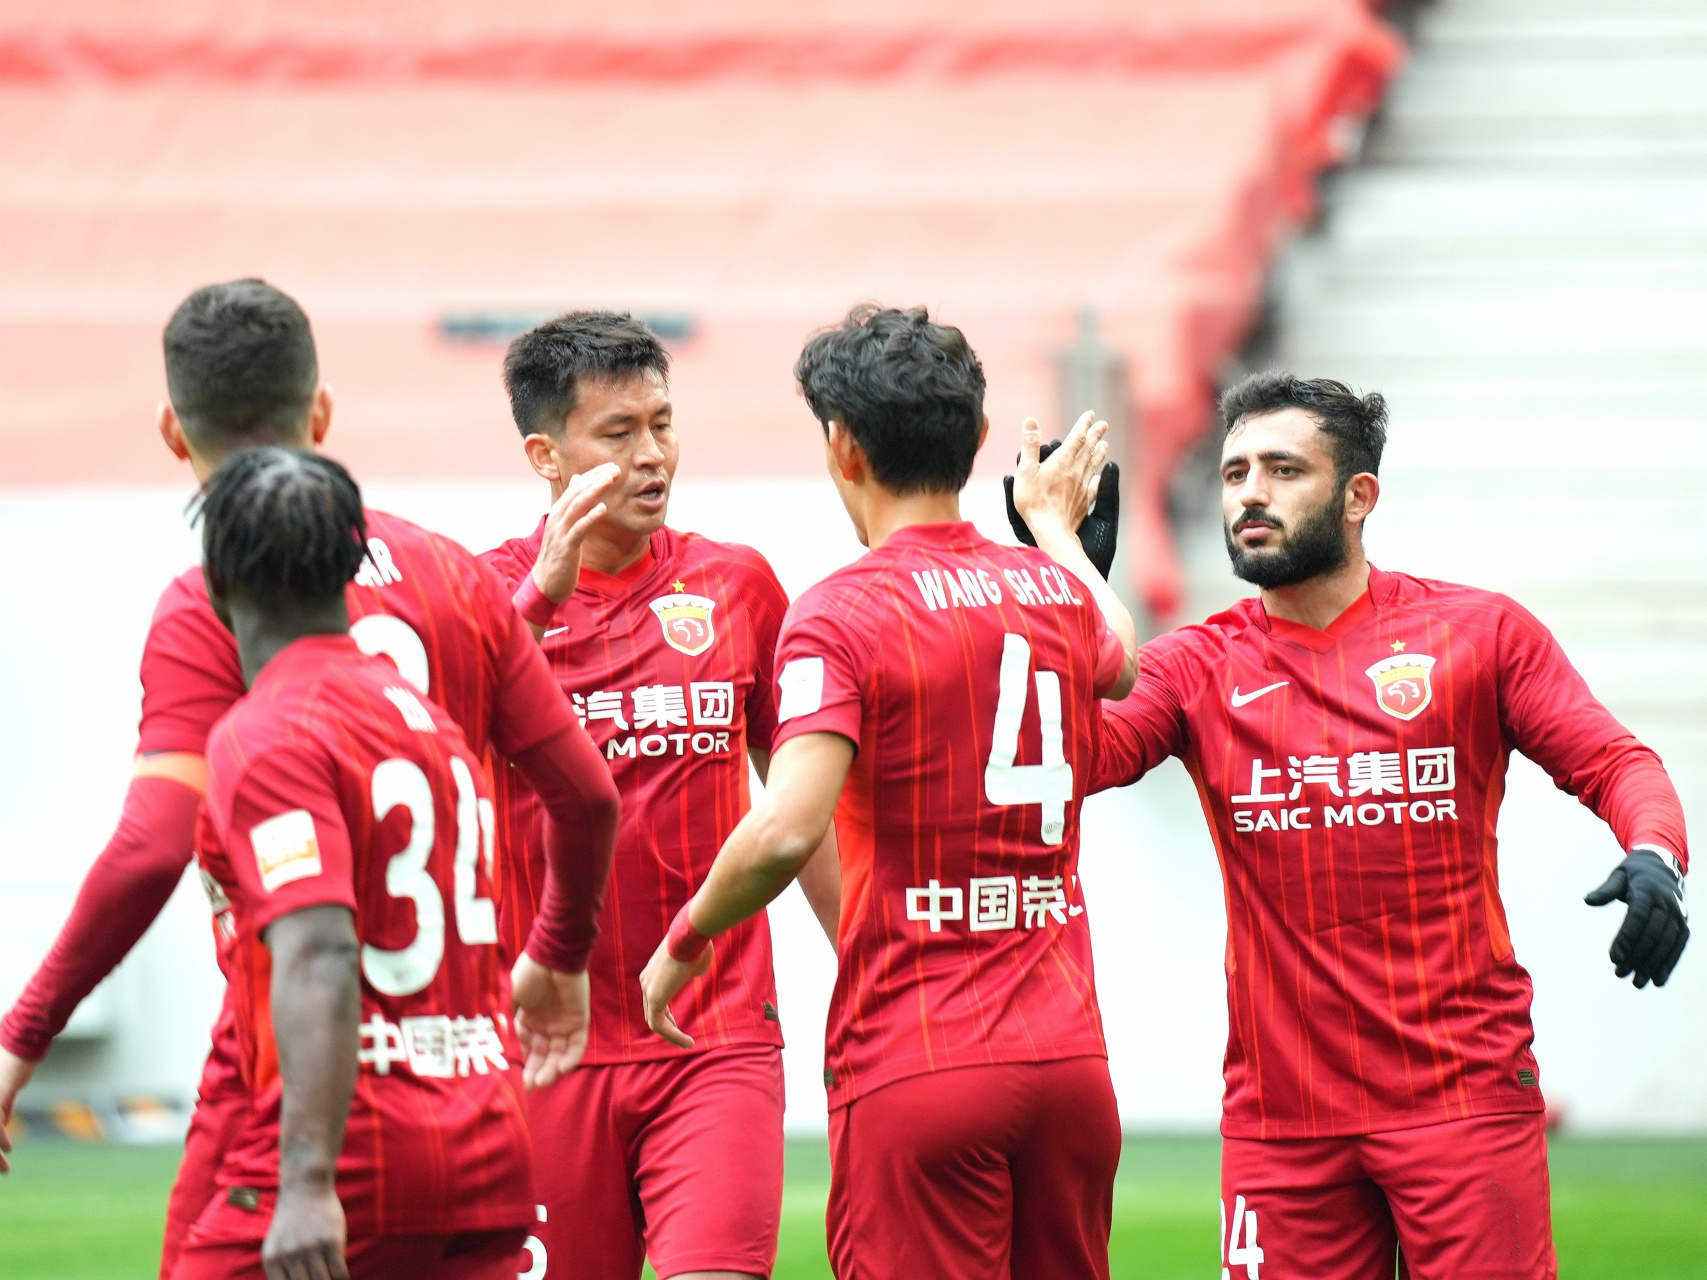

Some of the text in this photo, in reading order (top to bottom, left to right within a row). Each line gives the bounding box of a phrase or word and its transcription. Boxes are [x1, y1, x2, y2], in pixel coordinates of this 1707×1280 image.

[354, 537, 403, 588] AR
[911, 568, 1003, 611] WANG
[607, 731, 730, 760] MOTOR
[984, 632, 1074, 845] 4
[1231, 746, 1456, 804] 上汽集团
[1232, 798, 1459, 832] SAIC MOTOR
[361, 756, 499, 997] 34
[904, 874, 1084, 933] 中国荣
[356, 1013, 511, 1079] 中国荣
[1220, 1194, 1265, 1280] 4
